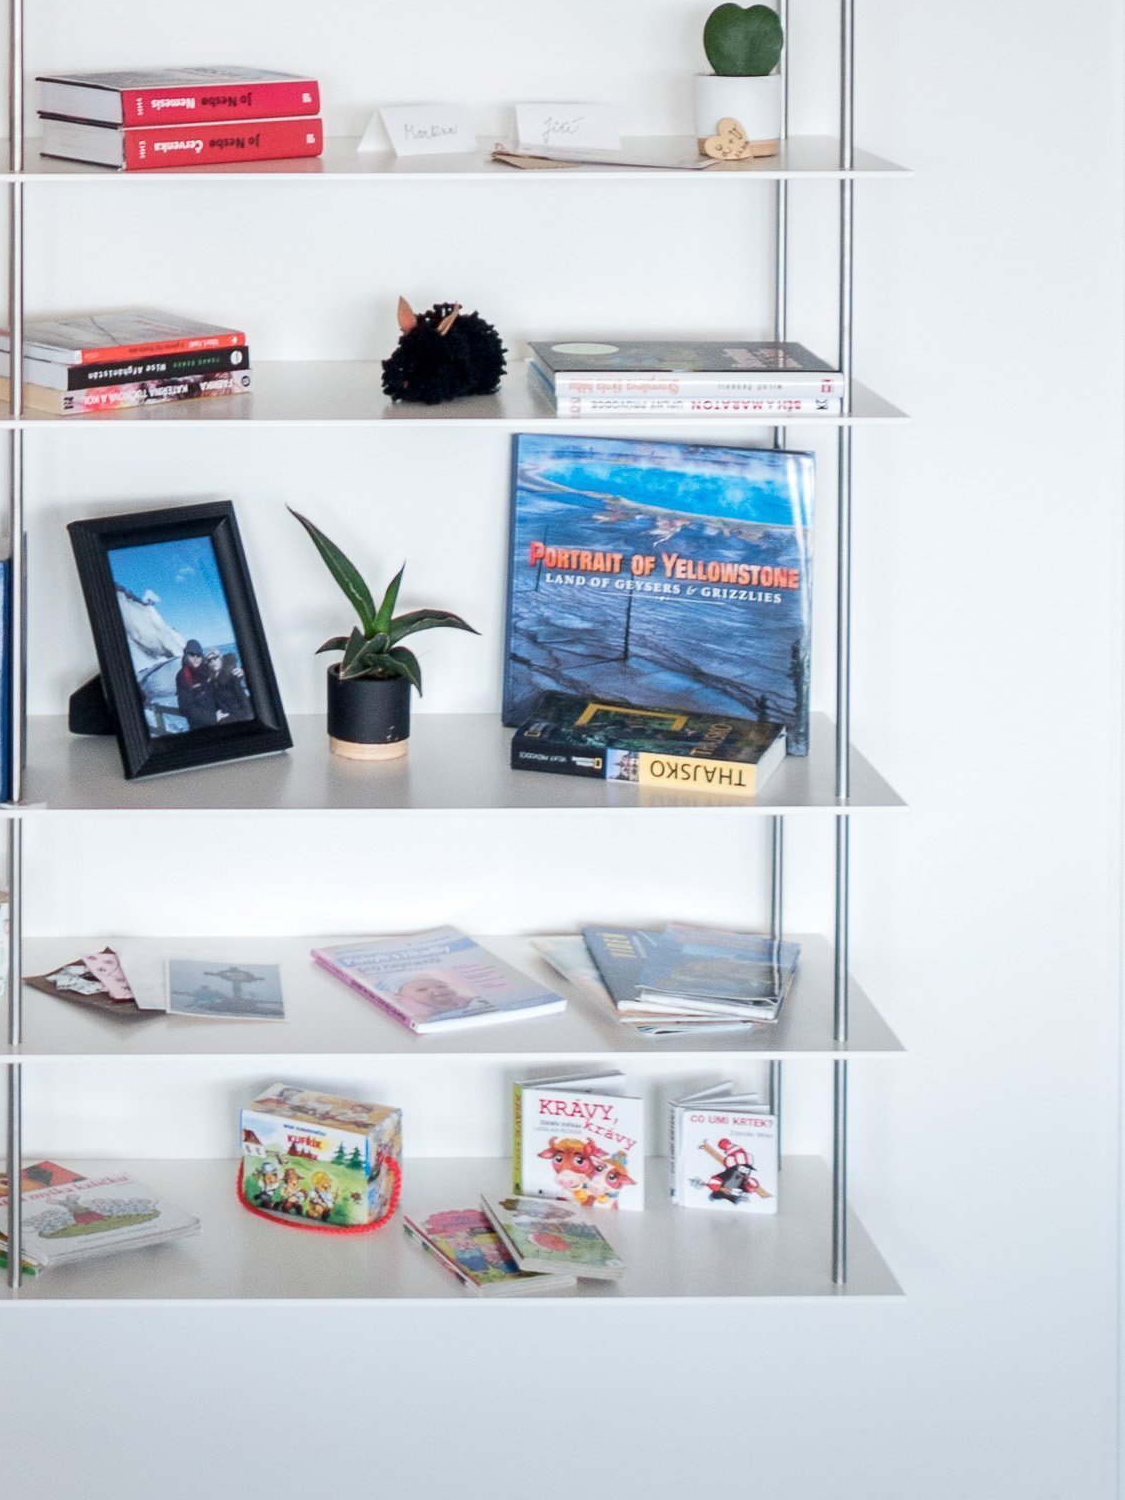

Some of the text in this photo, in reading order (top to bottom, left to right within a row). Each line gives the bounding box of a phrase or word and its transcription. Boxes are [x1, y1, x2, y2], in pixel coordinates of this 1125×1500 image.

[151, 96, 196, 112] Nemesis
[153, 139, 205, 156] Červenka
[87, 362, 167, 381] Mise Afghánistán
[149, 383, 189, 401] KATEŘINA
[199, 378, 234, 392] FABRIKA
[690, 400, 764, 410] MARATON
[778, 400, 802, 412] BĚH
[545, 572, 783, 605] LAND OF GEYSERS & GRIZZLIES
[649, 760, 748, 788] THAJSKO
[538, 1098, 619, 1125] KRÁVY,
[690, 1114, 705, 1124] CO
[732, 1116, 775, 1129] KRTEK?
[583, 1117, 638, 1151] krávy
